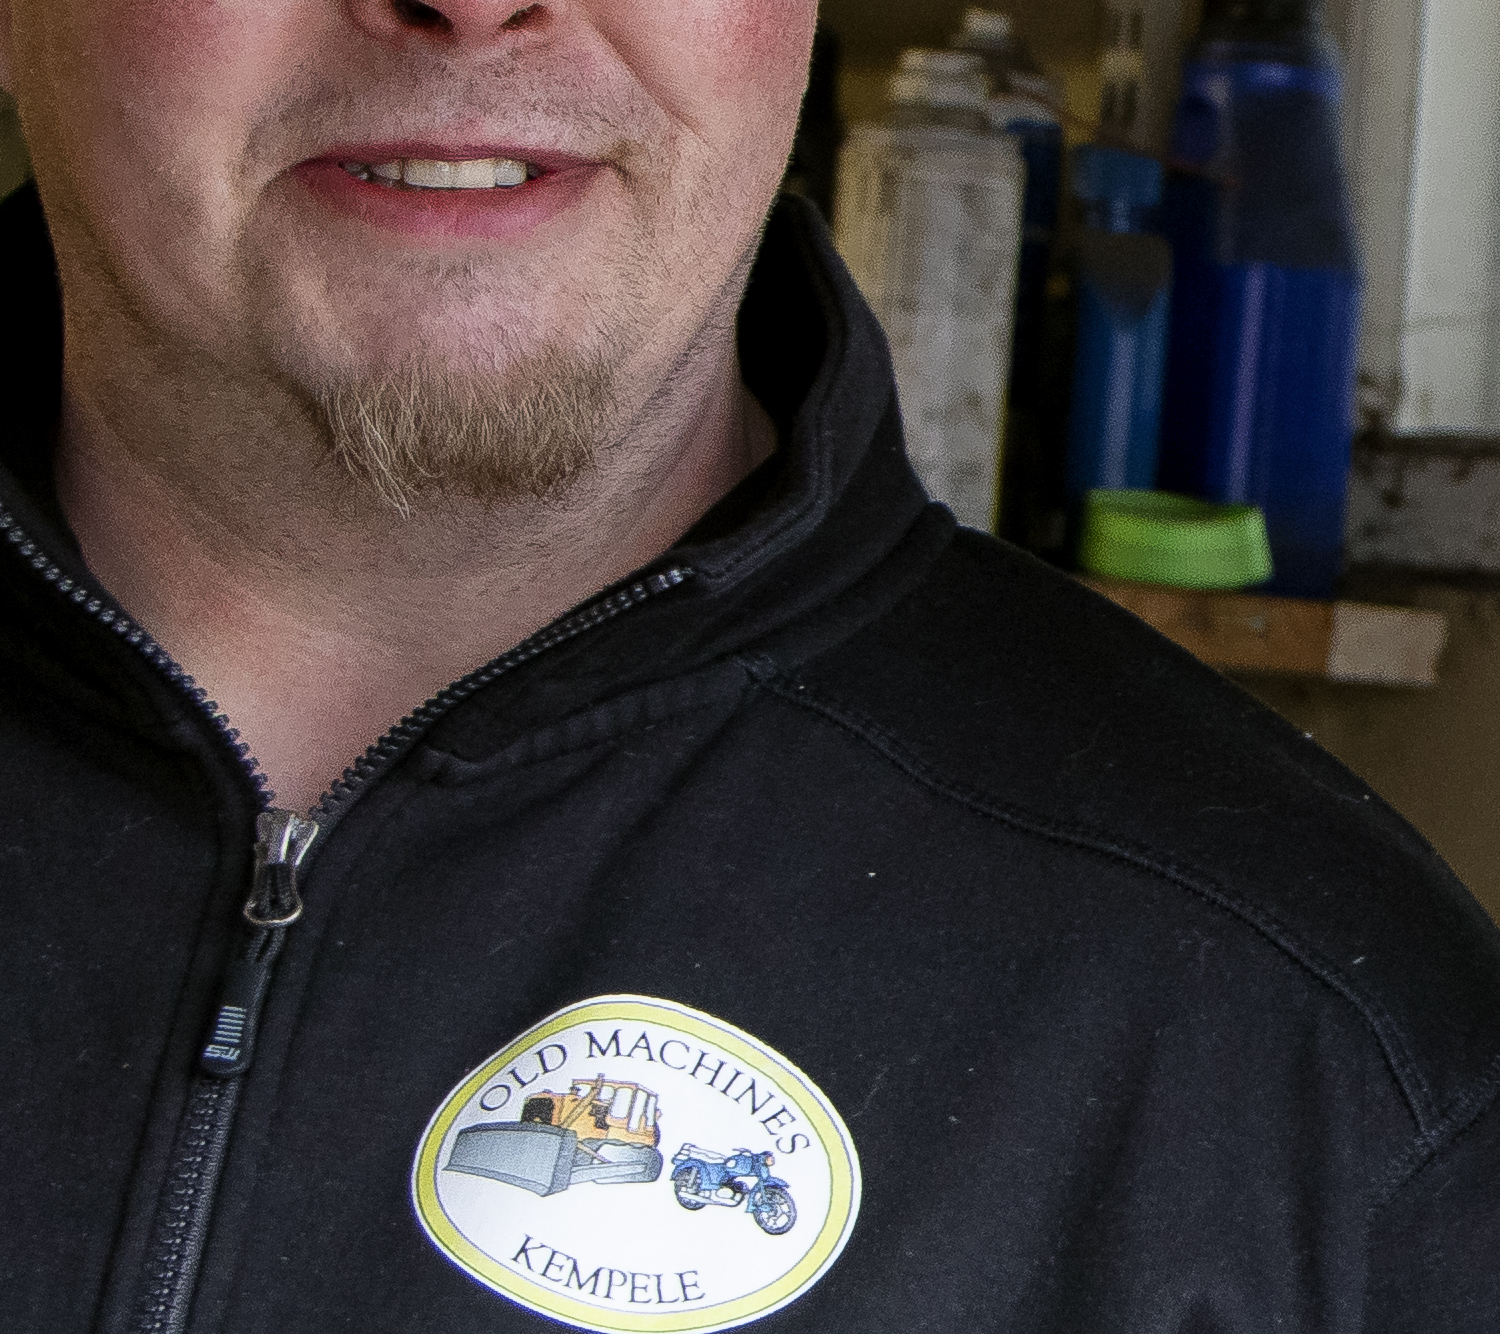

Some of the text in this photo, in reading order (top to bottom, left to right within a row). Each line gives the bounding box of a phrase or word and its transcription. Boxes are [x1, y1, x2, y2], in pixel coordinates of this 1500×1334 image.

[478, 1028, 812, 1156] OLD MACHINES
[510, 1233, 706, 1305] KEMPELE
